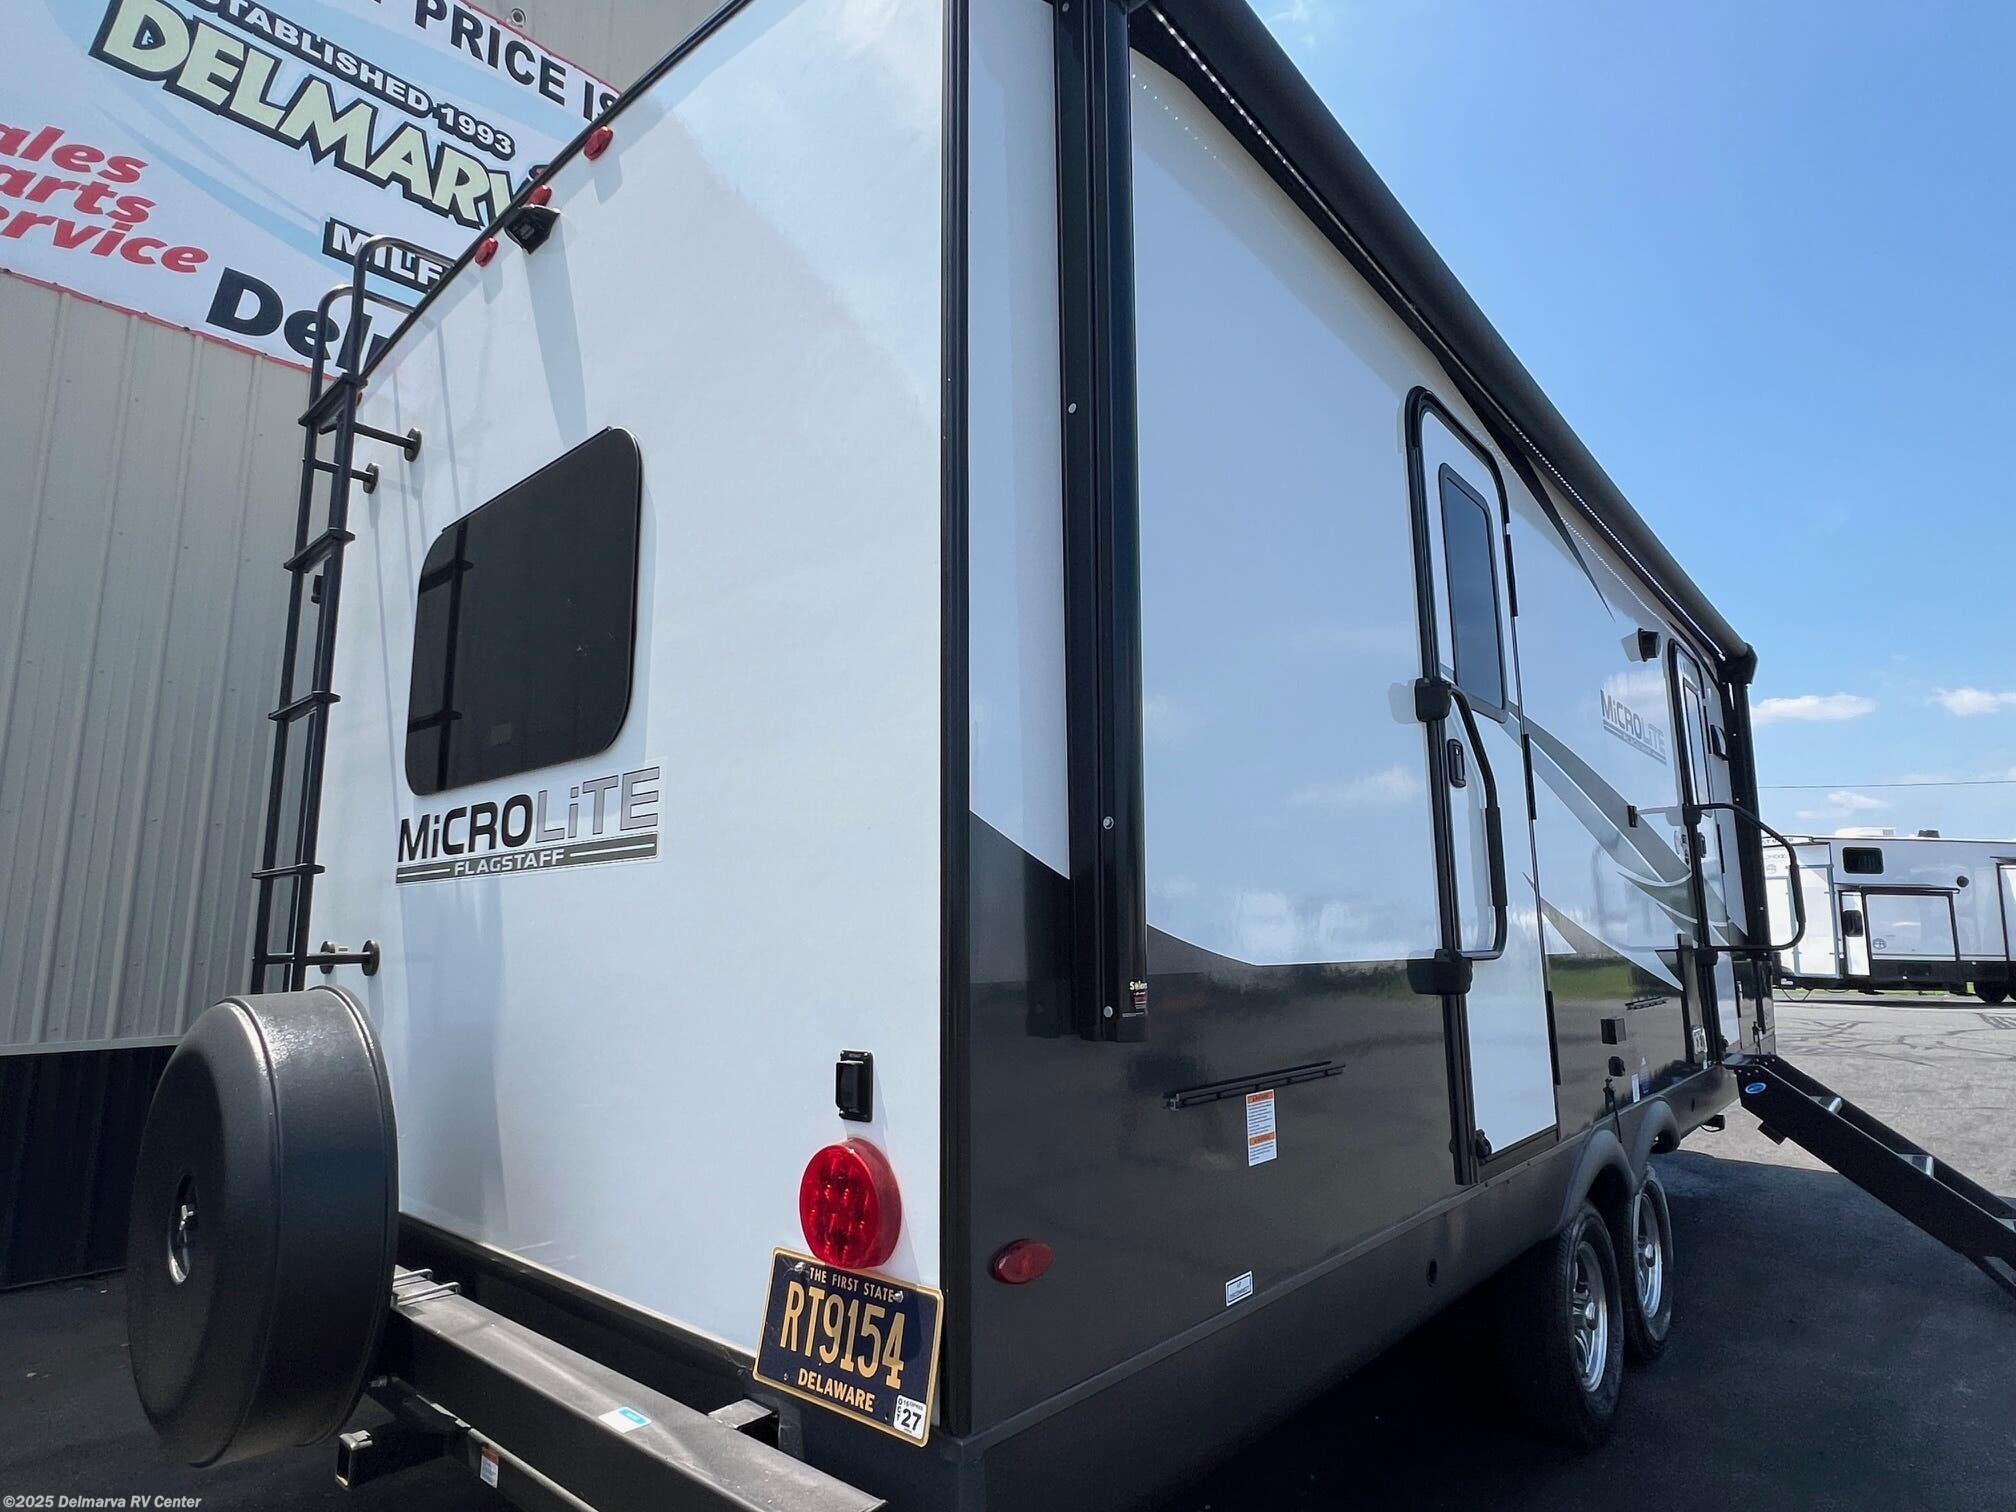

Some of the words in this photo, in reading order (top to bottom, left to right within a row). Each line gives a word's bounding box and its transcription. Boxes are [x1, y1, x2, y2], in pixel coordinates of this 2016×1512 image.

[414, 0, 567, 106] PRICE
[440, 105, 514, 155] 1993
[0, 205, 208, 273] rvice
[454, 849, 565, 876] FLAGSTAFF
[809, 1267, 827, 1284] THE
[831, 1274, 858, 1292] FIRST
[864, 1282, 894, 1302] STATE
[780, 1281, 905, 1390] RT9154
[797, 1368, 876, 1413] DELAWARE
[901, 1408, 922, 1430] 27
